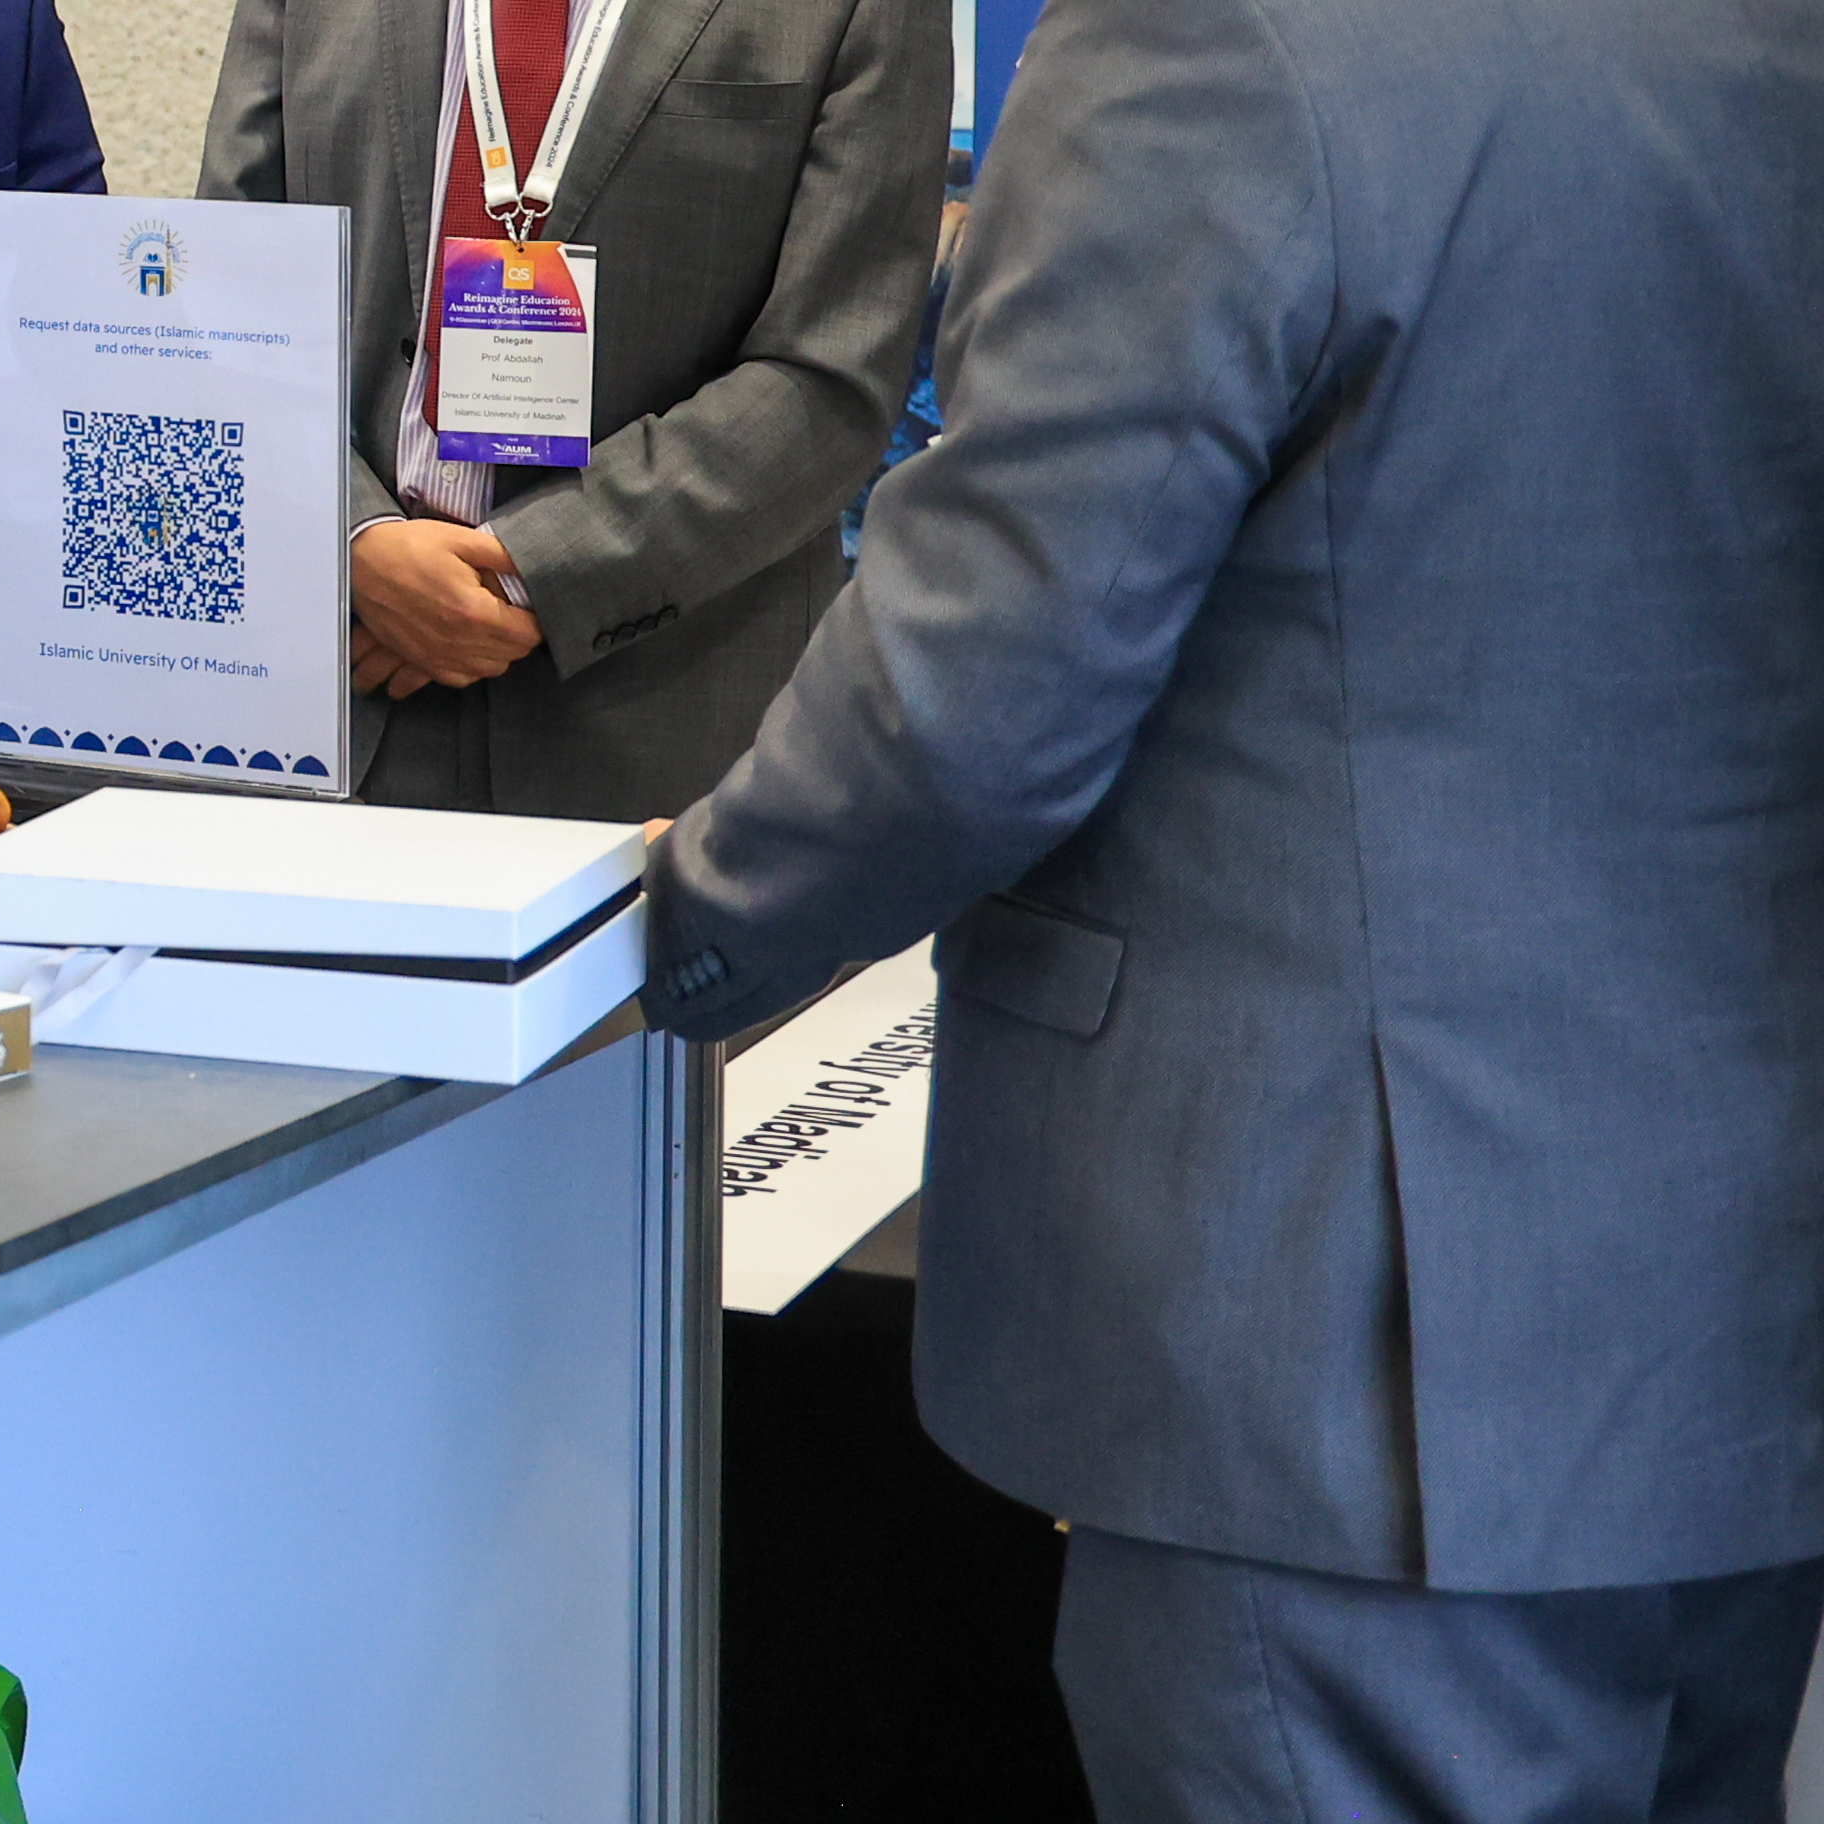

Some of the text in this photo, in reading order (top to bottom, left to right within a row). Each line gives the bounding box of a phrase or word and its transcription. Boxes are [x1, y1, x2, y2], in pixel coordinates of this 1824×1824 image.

[474, 33, 482, 59] Awards
[582, 26, 601, 64] Education
[477, 61, 487, 99] Education
[571, 65, 587, 92] Awards
[482, 101, 495, 141] Reimagine
[551, 100, 574, 146] Conference
[544, 146, 558, 167] 2024
[507, 267, 530, 282] QS
[448, 302, 558, 316] Awards & Conference
[463, 293, 571, 306] Reimagine Education
[19, 317, 291, 348] Request data sources (Islamic manuscripts)
[493, 335, 533, 346] Delegate
[94, 341, 213, 360] and other services:
[481, 353, 543, 364] Prof Abdallah
[491, 373, 532, 383] Namoun
[442, 391, 470, 400] Director
[483, 393, 512, 401] Artificial
[513, 395, 554, 404] Intelligence
[454, 408, 481, 417] Islamic
[483, 410, 521, 420] University
[532, 412, 566, 421] Madinah
[504, 445, 532, 454] AUM
[39, 642, 269, 679] Islamic University Of Madinah
[722, 1001, 938, 1197] ersity of Madinah
